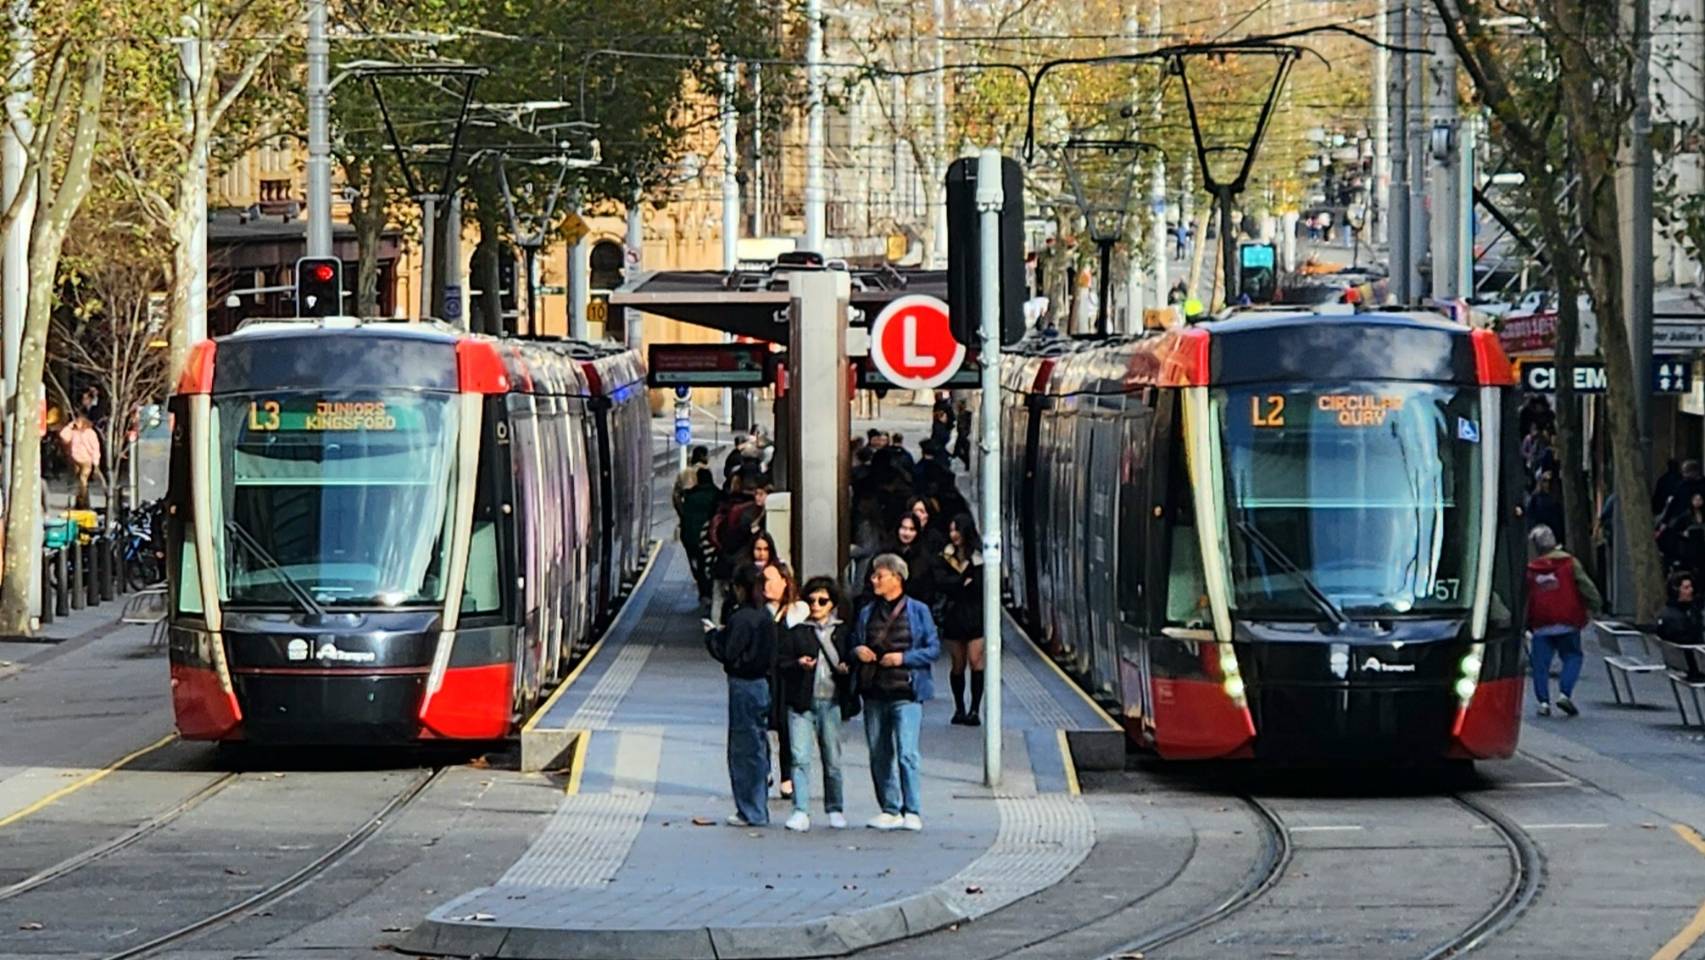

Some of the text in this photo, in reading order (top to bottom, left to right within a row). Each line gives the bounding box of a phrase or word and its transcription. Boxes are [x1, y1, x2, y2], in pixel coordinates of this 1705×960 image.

[903, 315, 937, 367] L
[1528, 367, 1607, 389] CIEM
[316, 402, 386, 416] JUNIORS
[1251, 395, 1285, 427] L2
[1318, 395, 1404, 411] CIRCULAR
[249, 401, 280, 431] L3
[305, 416, 397, 431] KINGSFORD
[1338, 410, 1388, 426] QUAY
